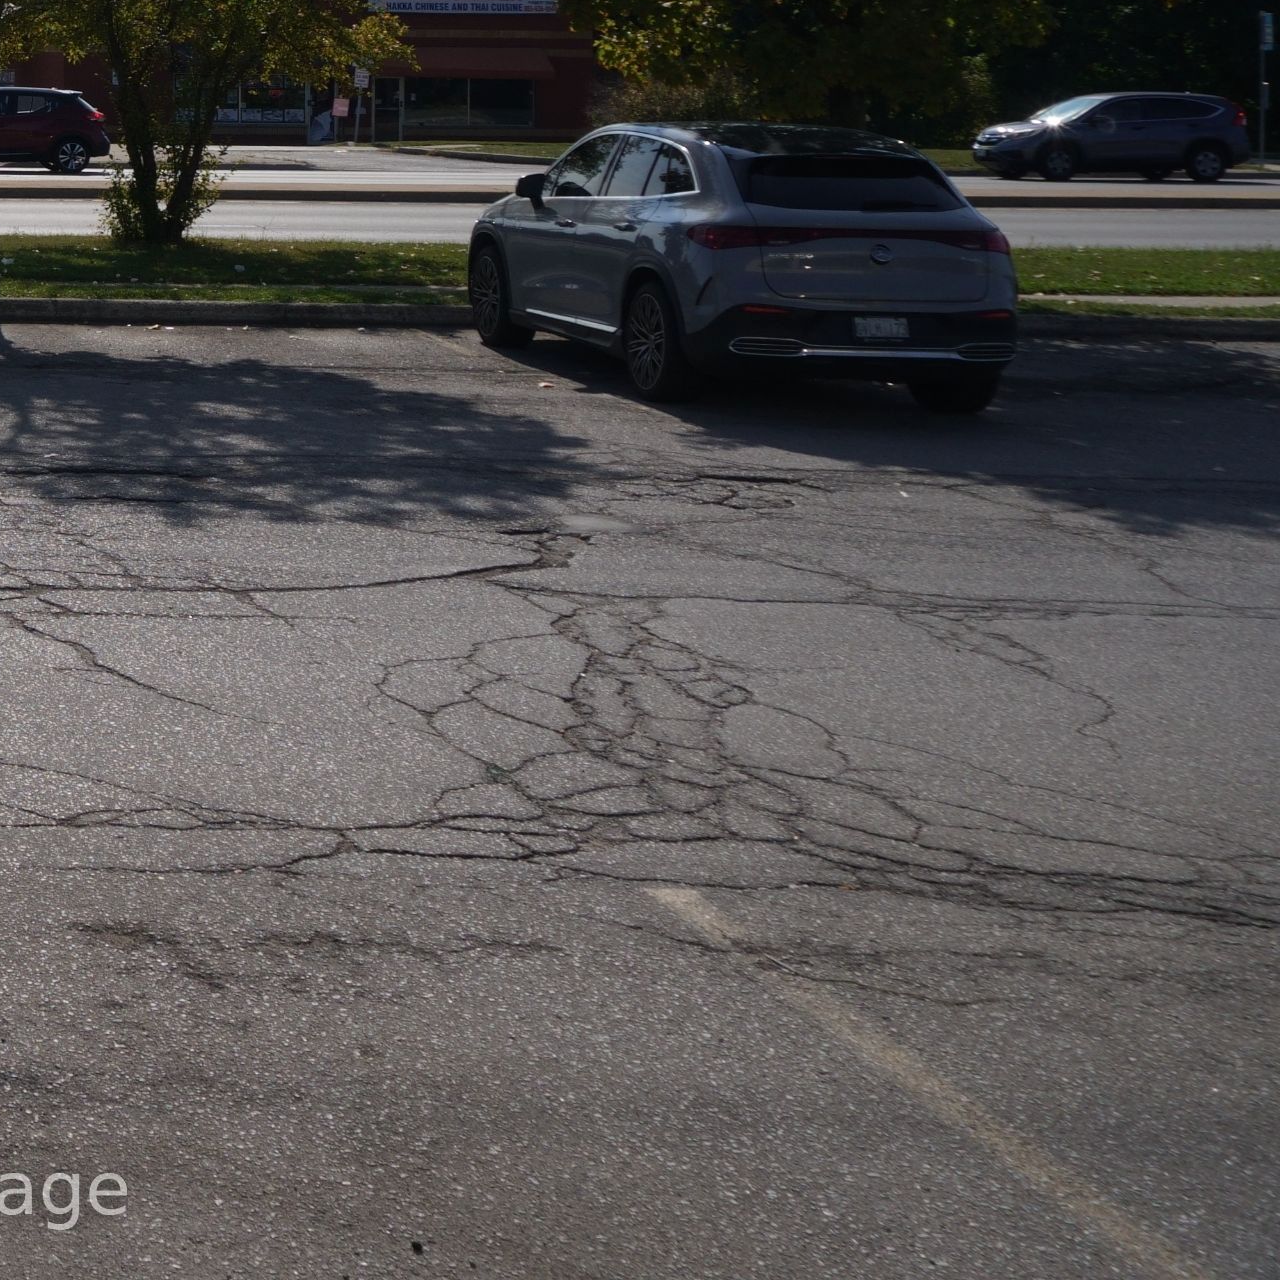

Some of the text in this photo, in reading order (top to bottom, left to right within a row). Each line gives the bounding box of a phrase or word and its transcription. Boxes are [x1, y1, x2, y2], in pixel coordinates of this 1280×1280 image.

[386, 2, 412, 11] HAKKA
[415, 2, 449, 11] CHINESE
[452, 2, 468, 11] AND
[471, 3, 488, 11] THAI
[491, 3, 523, 12] CUISINE
